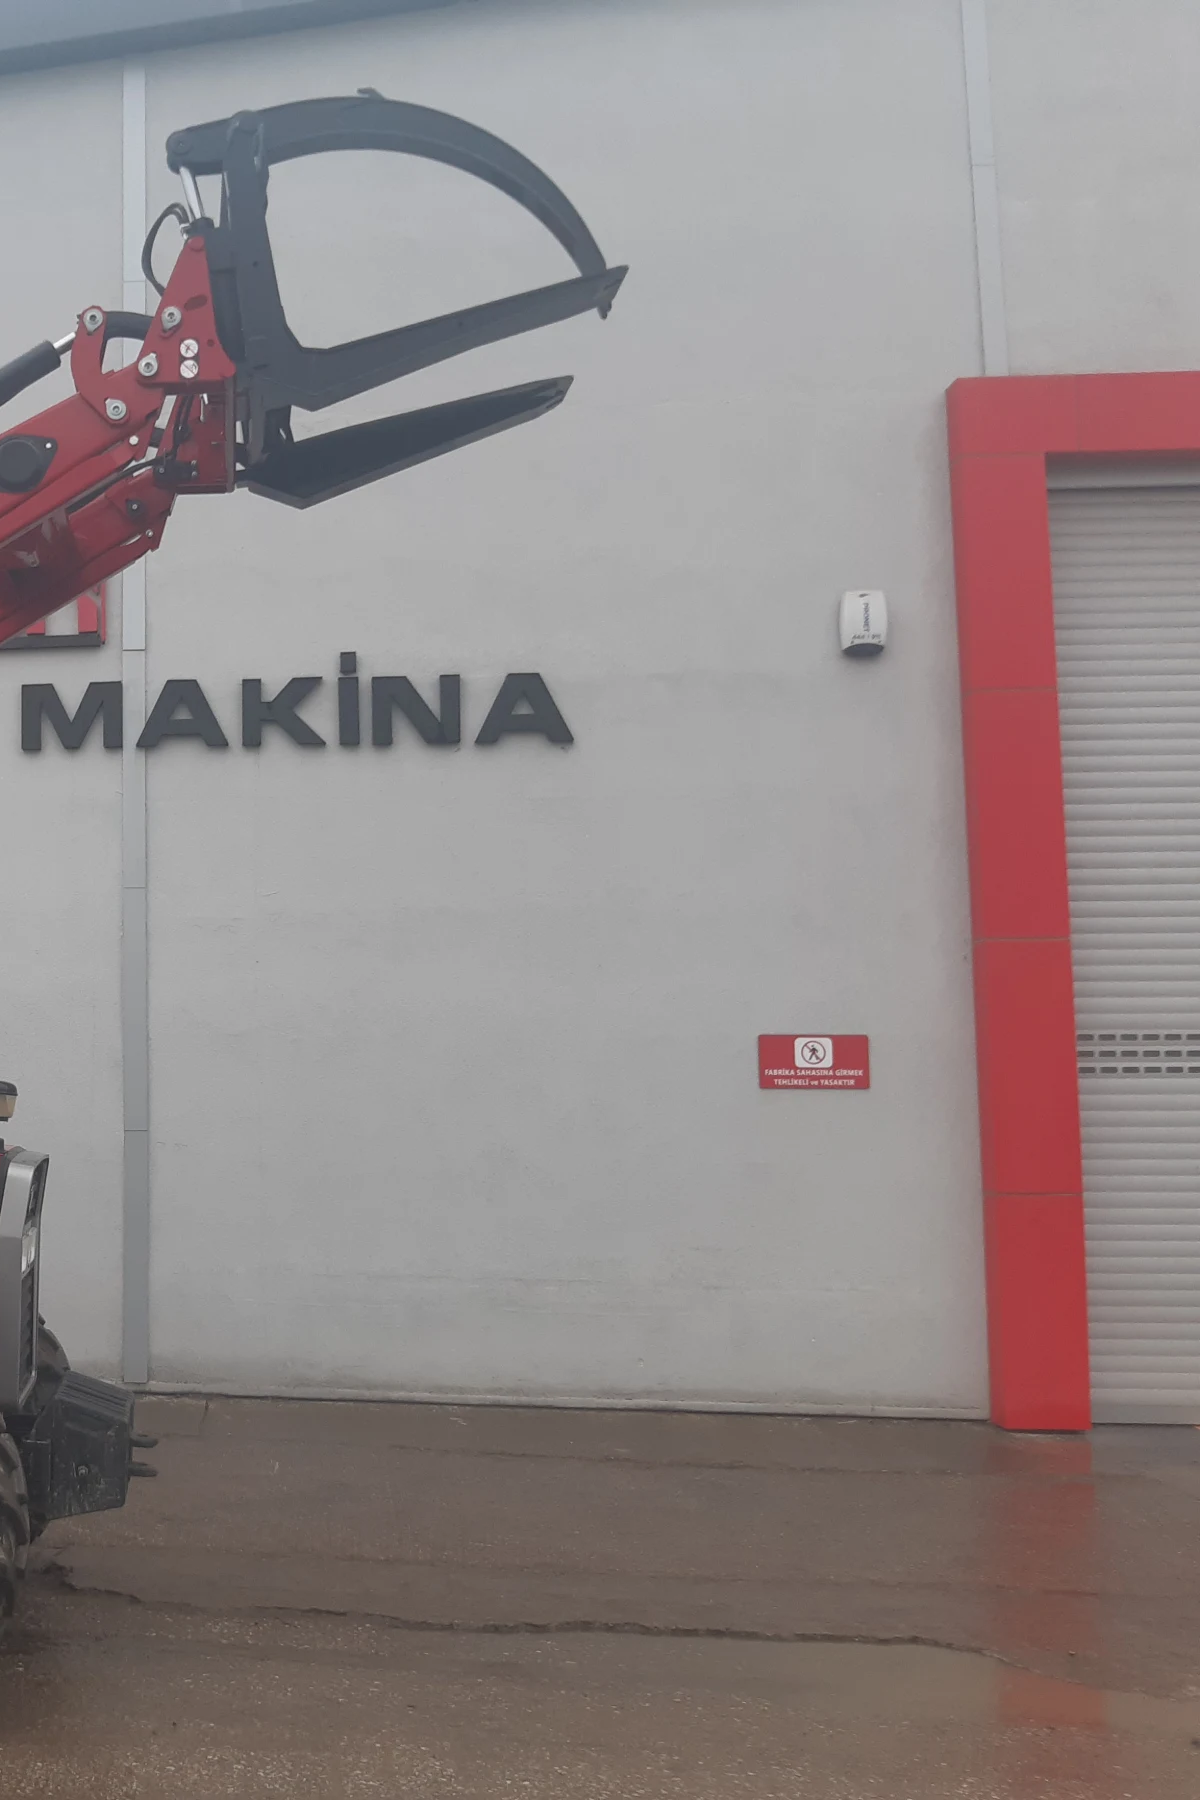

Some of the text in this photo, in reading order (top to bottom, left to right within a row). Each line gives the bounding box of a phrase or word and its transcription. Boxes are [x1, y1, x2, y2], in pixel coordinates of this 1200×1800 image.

[21, 651, 574, 751] MAKİNA
[764, 1068, 794, 1076] FABRİKA
[835, 1068, 863, 1076] GİRMEK
[774, 1078, 808, 1086] TEHLİKELİ
